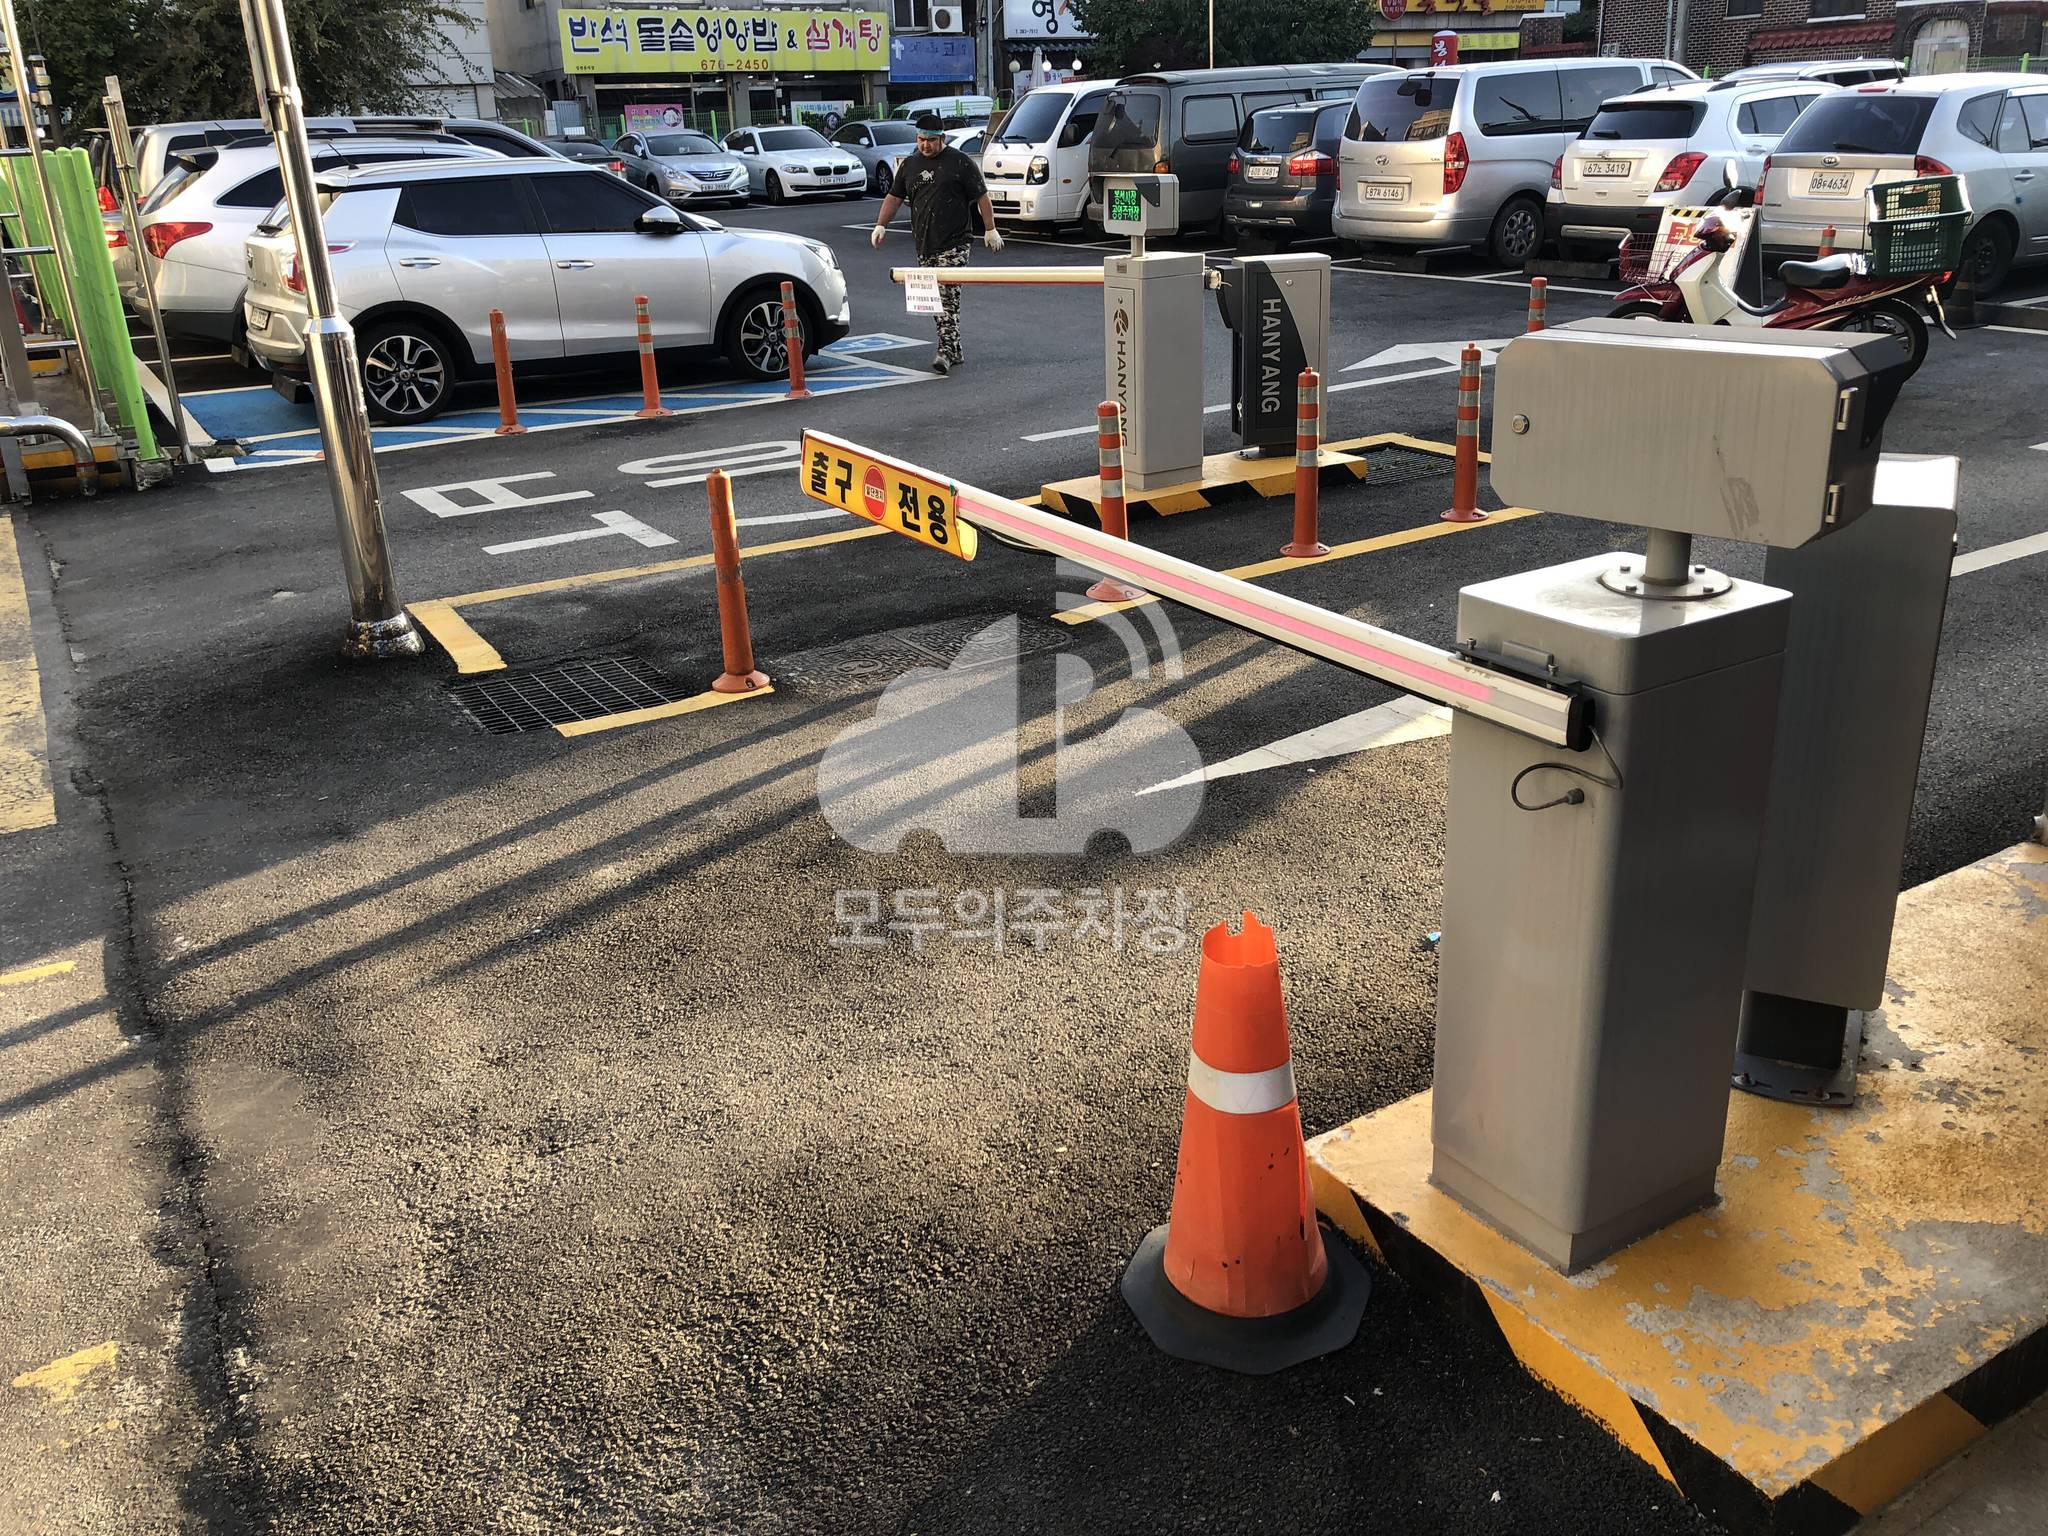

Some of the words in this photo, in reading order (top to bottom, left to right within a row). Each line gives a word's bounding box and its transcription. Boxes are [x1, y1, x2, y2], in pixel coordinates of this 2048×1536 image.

[568, 16, 629, 53] 반석
[636, 15, 778, 53] 돌솥영양밥
[786, 29, 799, 50] &
[805, 17, 882, 53] 삼계탕
[700, 58, 769, 71] 676-2450
[1605, 163, 1626, 173] 3419
[1383, 189, 1399, 198] 6146
[1261, 298, 1282, 413] HANYANG
[810, 450, 853, 505] 출구
[898, 481, 949, 545] 전용
